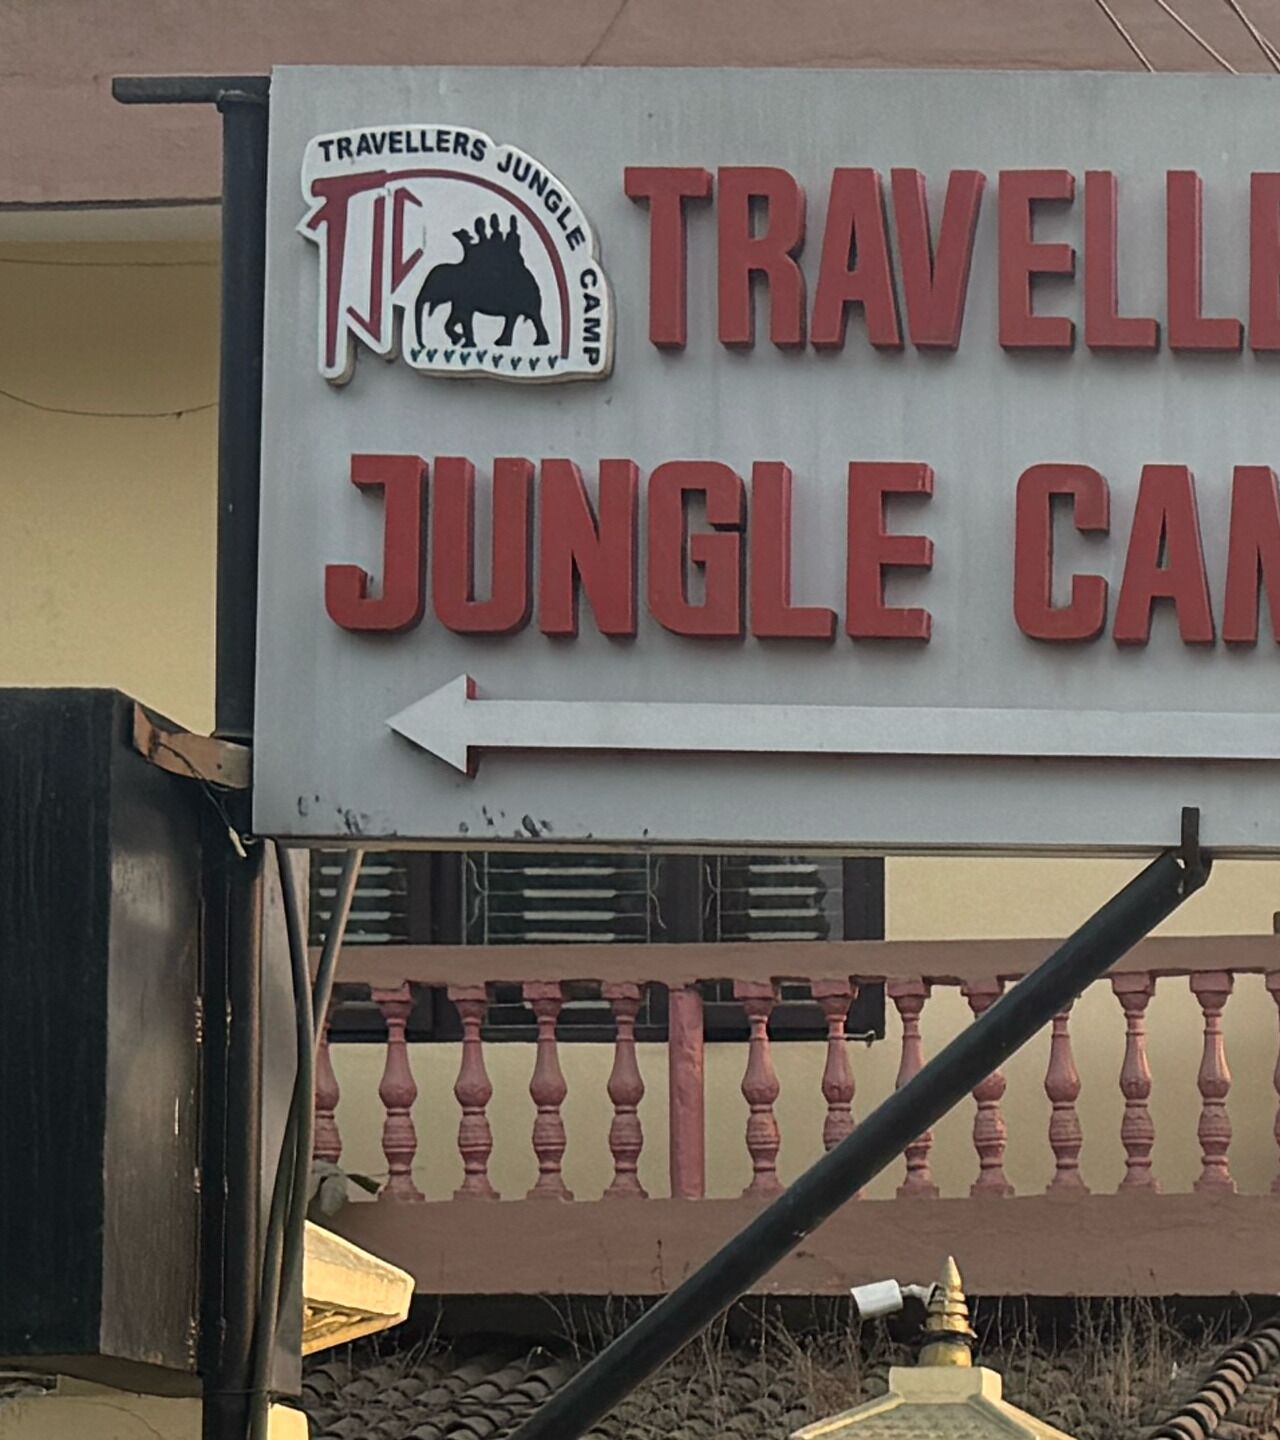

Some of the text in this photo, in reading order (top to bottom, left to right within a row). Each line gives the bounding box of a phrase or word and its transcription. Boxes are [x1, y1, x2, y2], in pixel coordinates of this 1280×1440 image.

[318, 129, 601, 367] TRAVELLERS JUNGLE CAMP
[323, 452, 935, 644] JUNGLE
